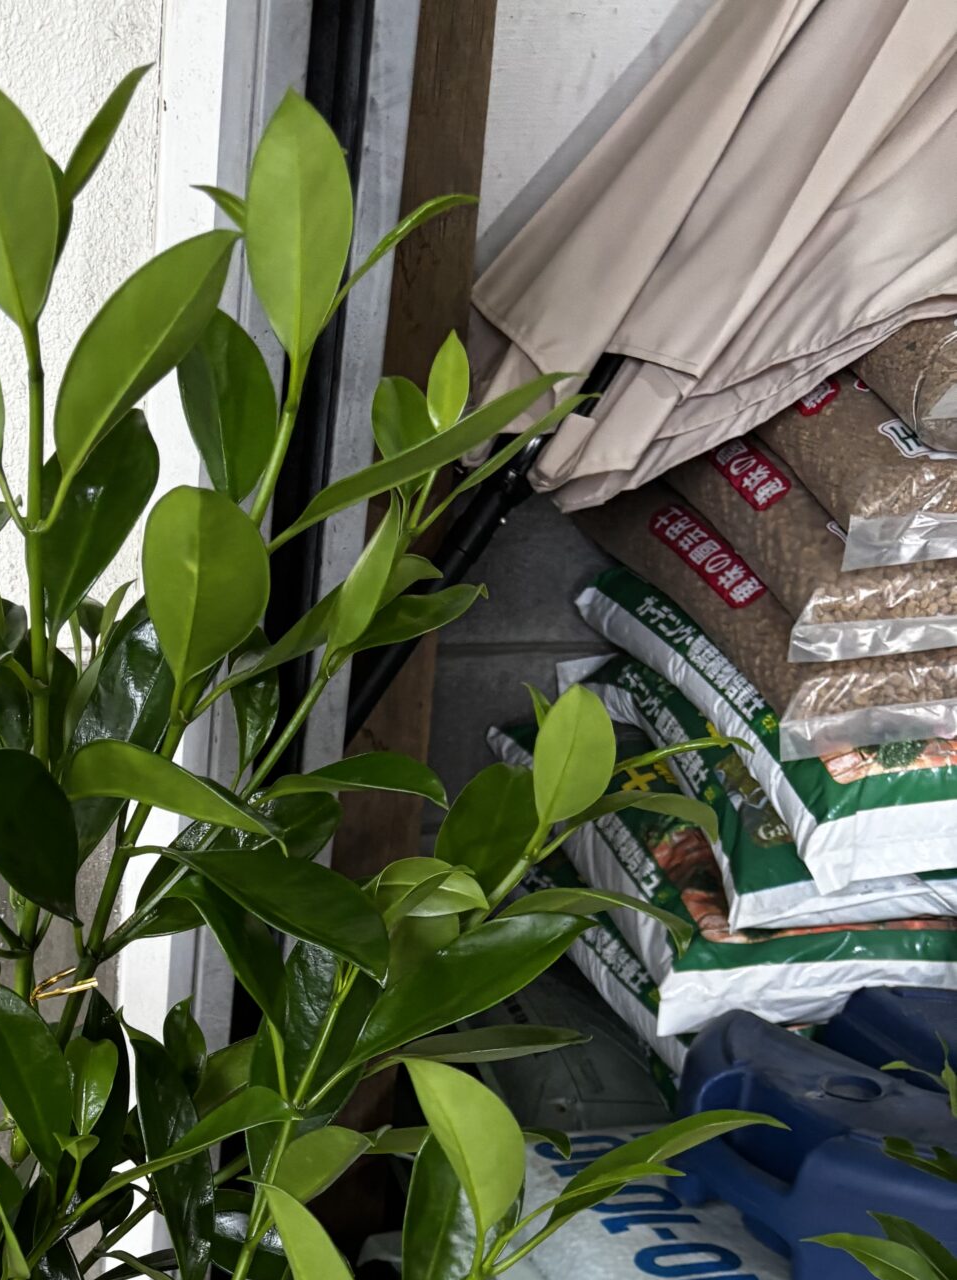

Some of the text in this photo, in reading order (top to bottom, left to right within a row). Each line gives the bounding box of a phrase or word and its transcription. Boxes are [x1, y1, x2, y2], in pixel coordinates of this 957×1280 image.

[715, 441, 787, 506] 趣味の園
[654, 507, 764, 605] 趣味の園芸用土
